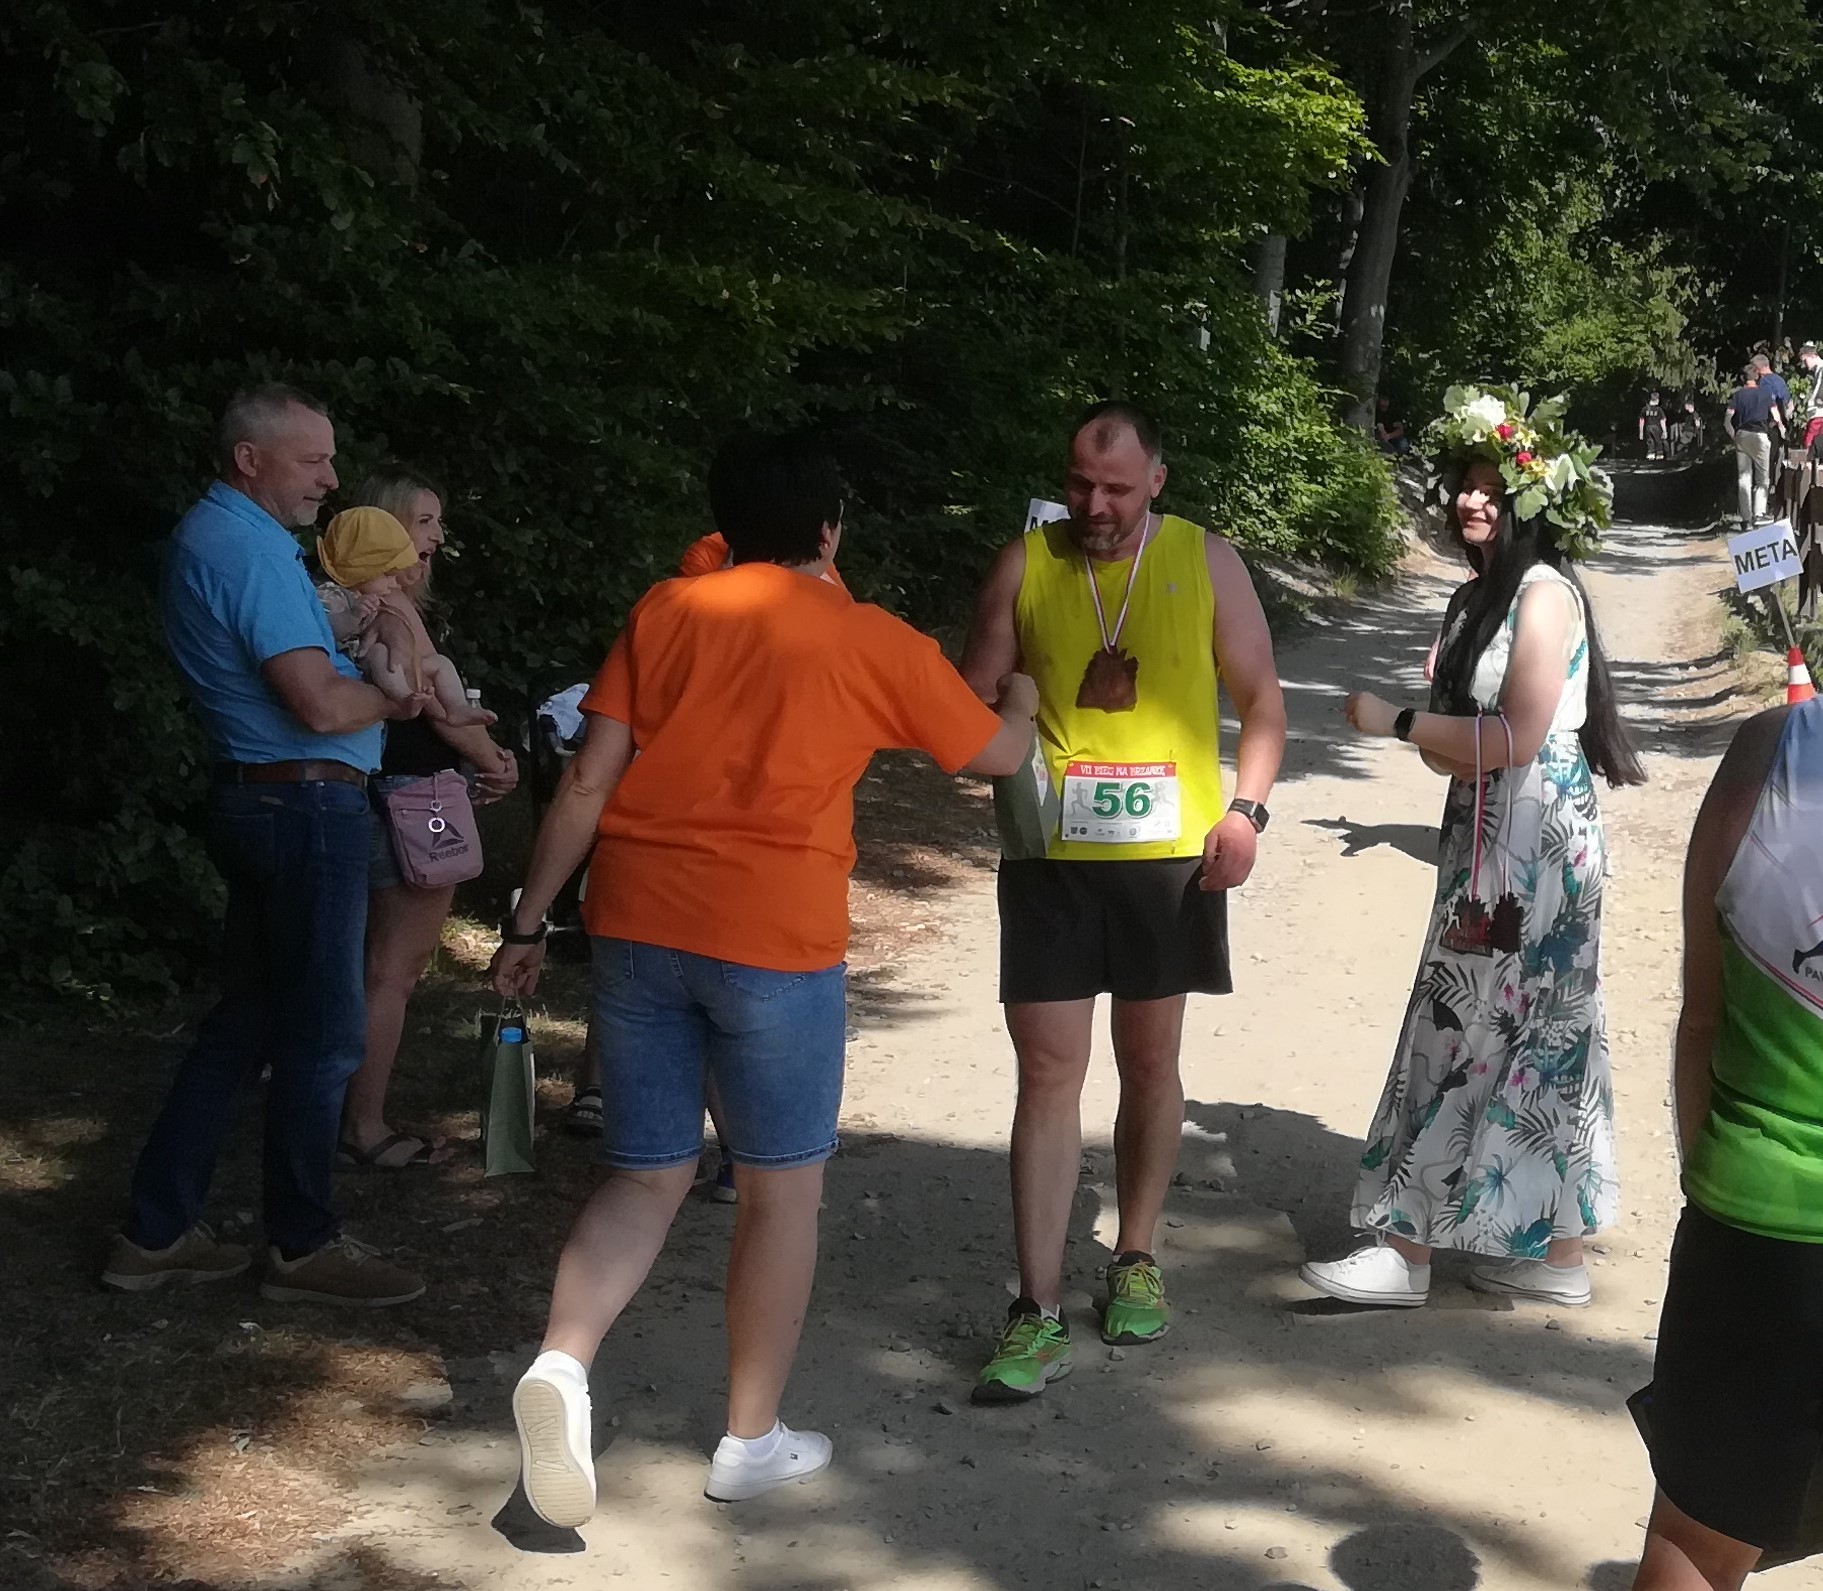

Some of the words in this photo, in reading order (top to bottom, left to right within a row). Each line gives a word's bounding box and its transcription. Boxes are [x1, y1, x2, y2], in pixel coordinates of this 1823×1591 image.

[1734, 538, 1798, 575] META
[1080, 764, 1092, 775] VII
[1094, 765, 1115, 776] BIEG
[1116, 765, 1129, 776] NA
[1092, 782, 1152, 818] 56
